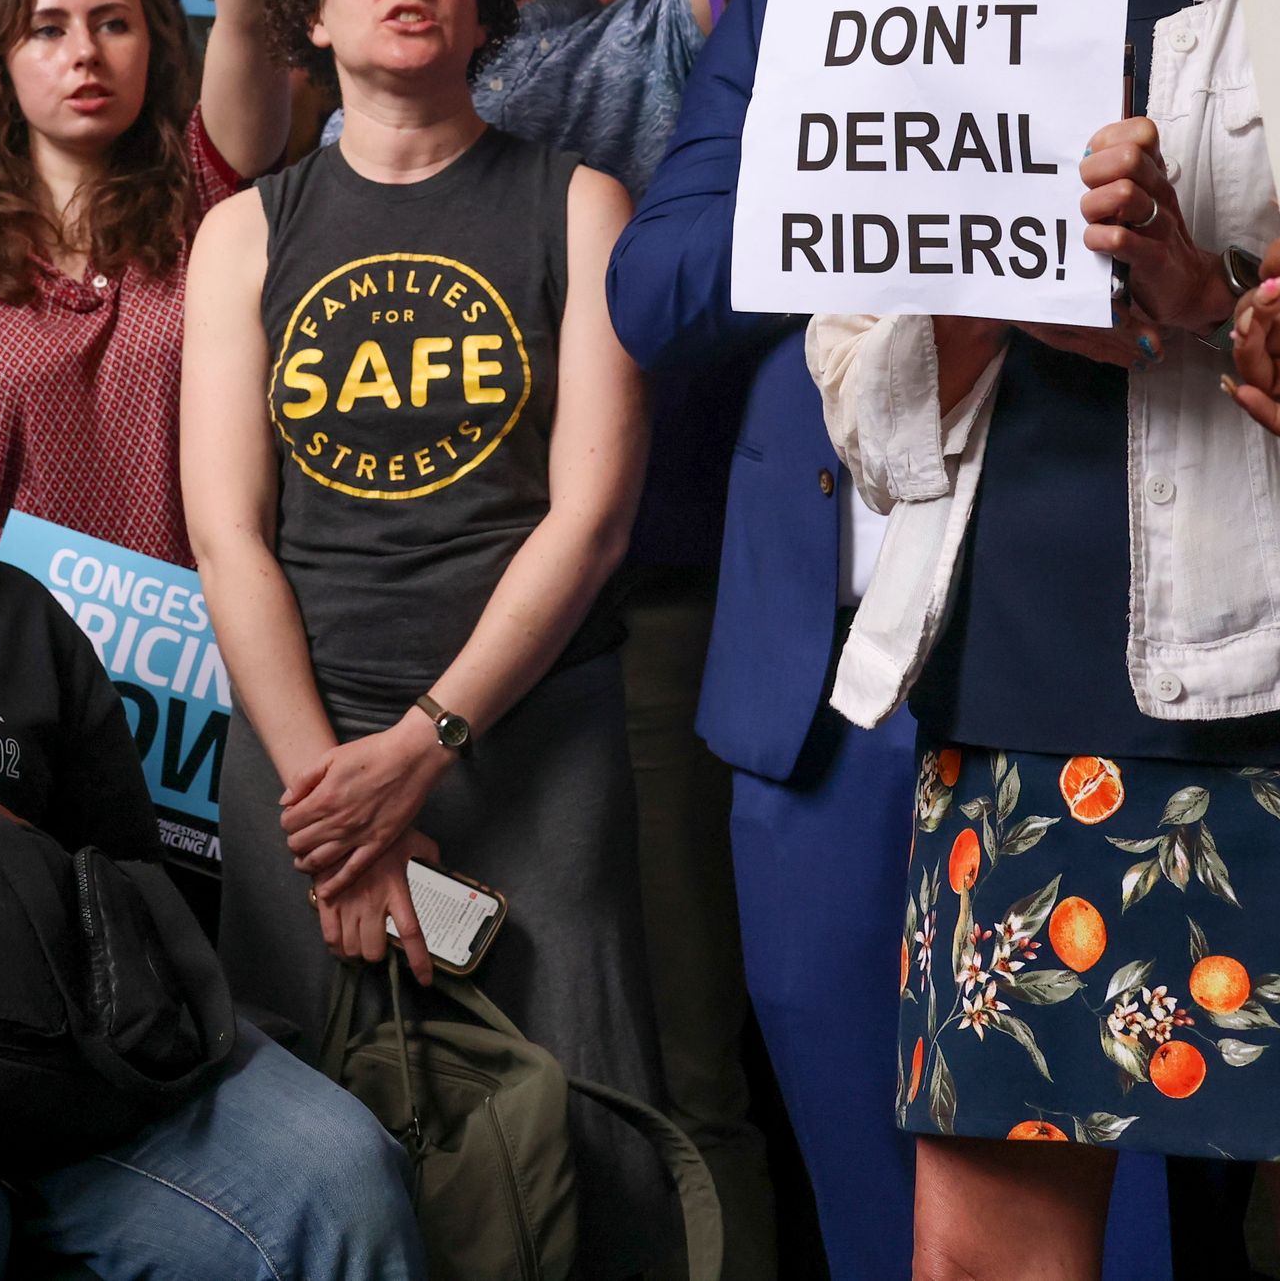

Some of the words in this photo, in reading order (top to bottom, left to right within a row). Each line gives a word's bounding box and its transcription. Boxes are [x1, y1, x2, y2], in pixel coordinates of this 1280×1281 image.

[824, 4, 1037, 67] DON'T
[797, 112, 1058, 174] DERAIL
[781, 213, 1066, 280] RIDERS!
[300, 270, 487, 338] FAMILIES
[372, 309, 414, 324] FOR
[282, 334, 506, 419] SAFE
[306, 420, 481, 481] STREETS
[49, 548, 212, 632] CONGES
[160, 829, 204, 855] RICING
